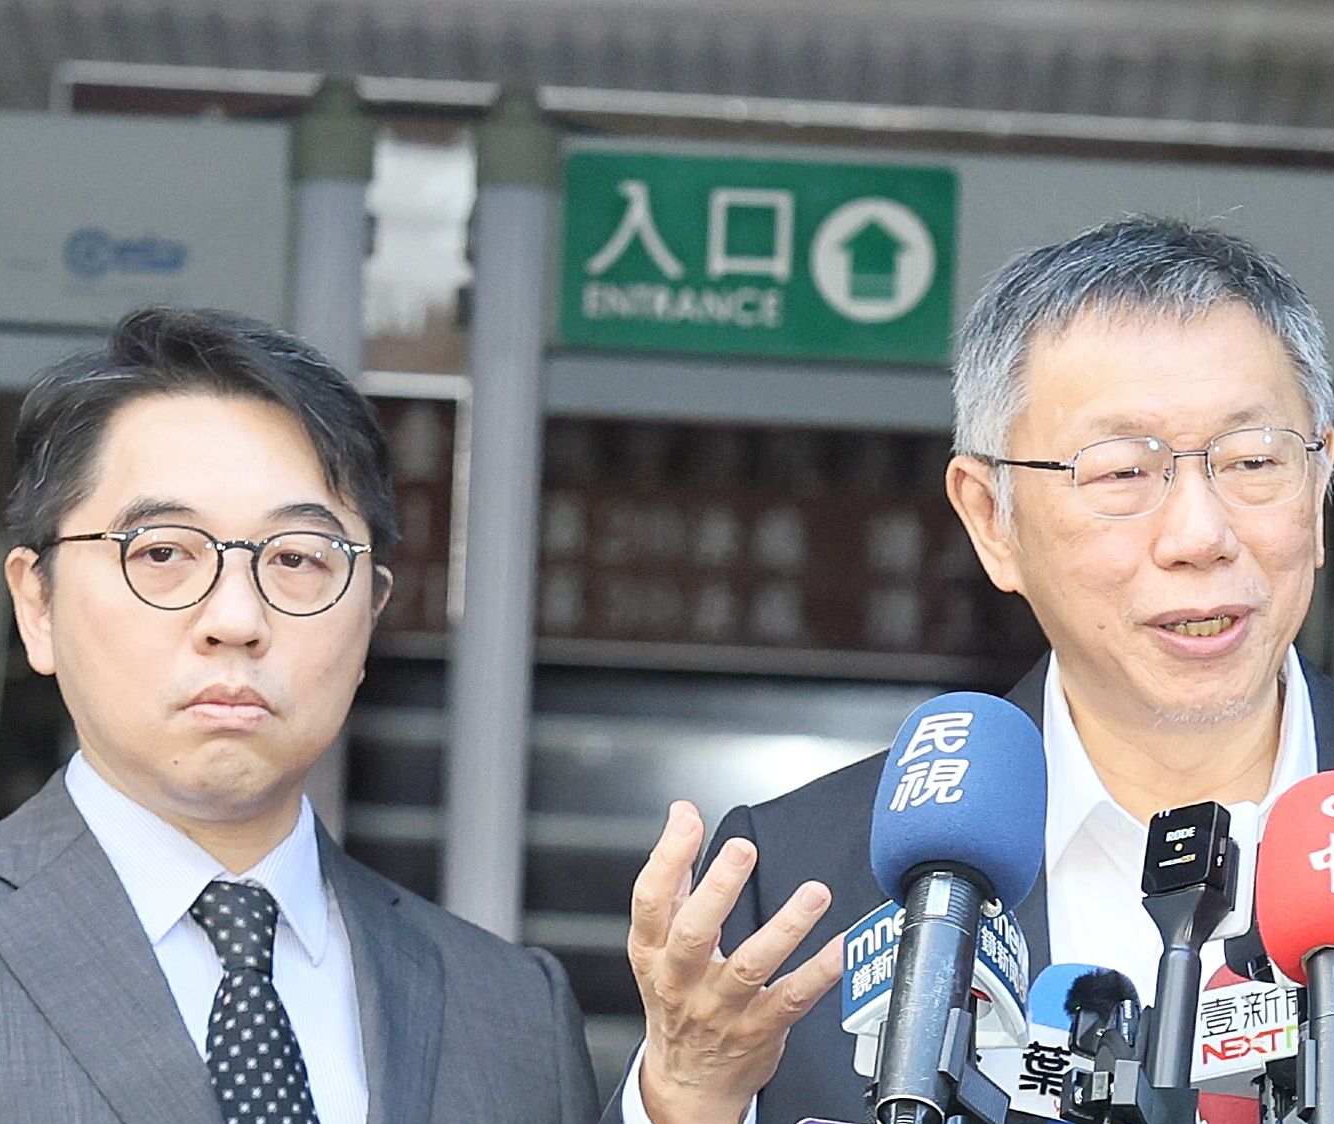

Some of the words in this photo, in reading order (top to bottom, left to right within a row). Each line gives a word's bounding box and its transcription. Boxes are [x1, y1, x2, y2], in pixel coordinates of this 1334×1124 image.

[584, 179, 796, 284] 入口
[582, 281, 785, 329] ENTRANCE
[889, 711, 974, 812] 民視
